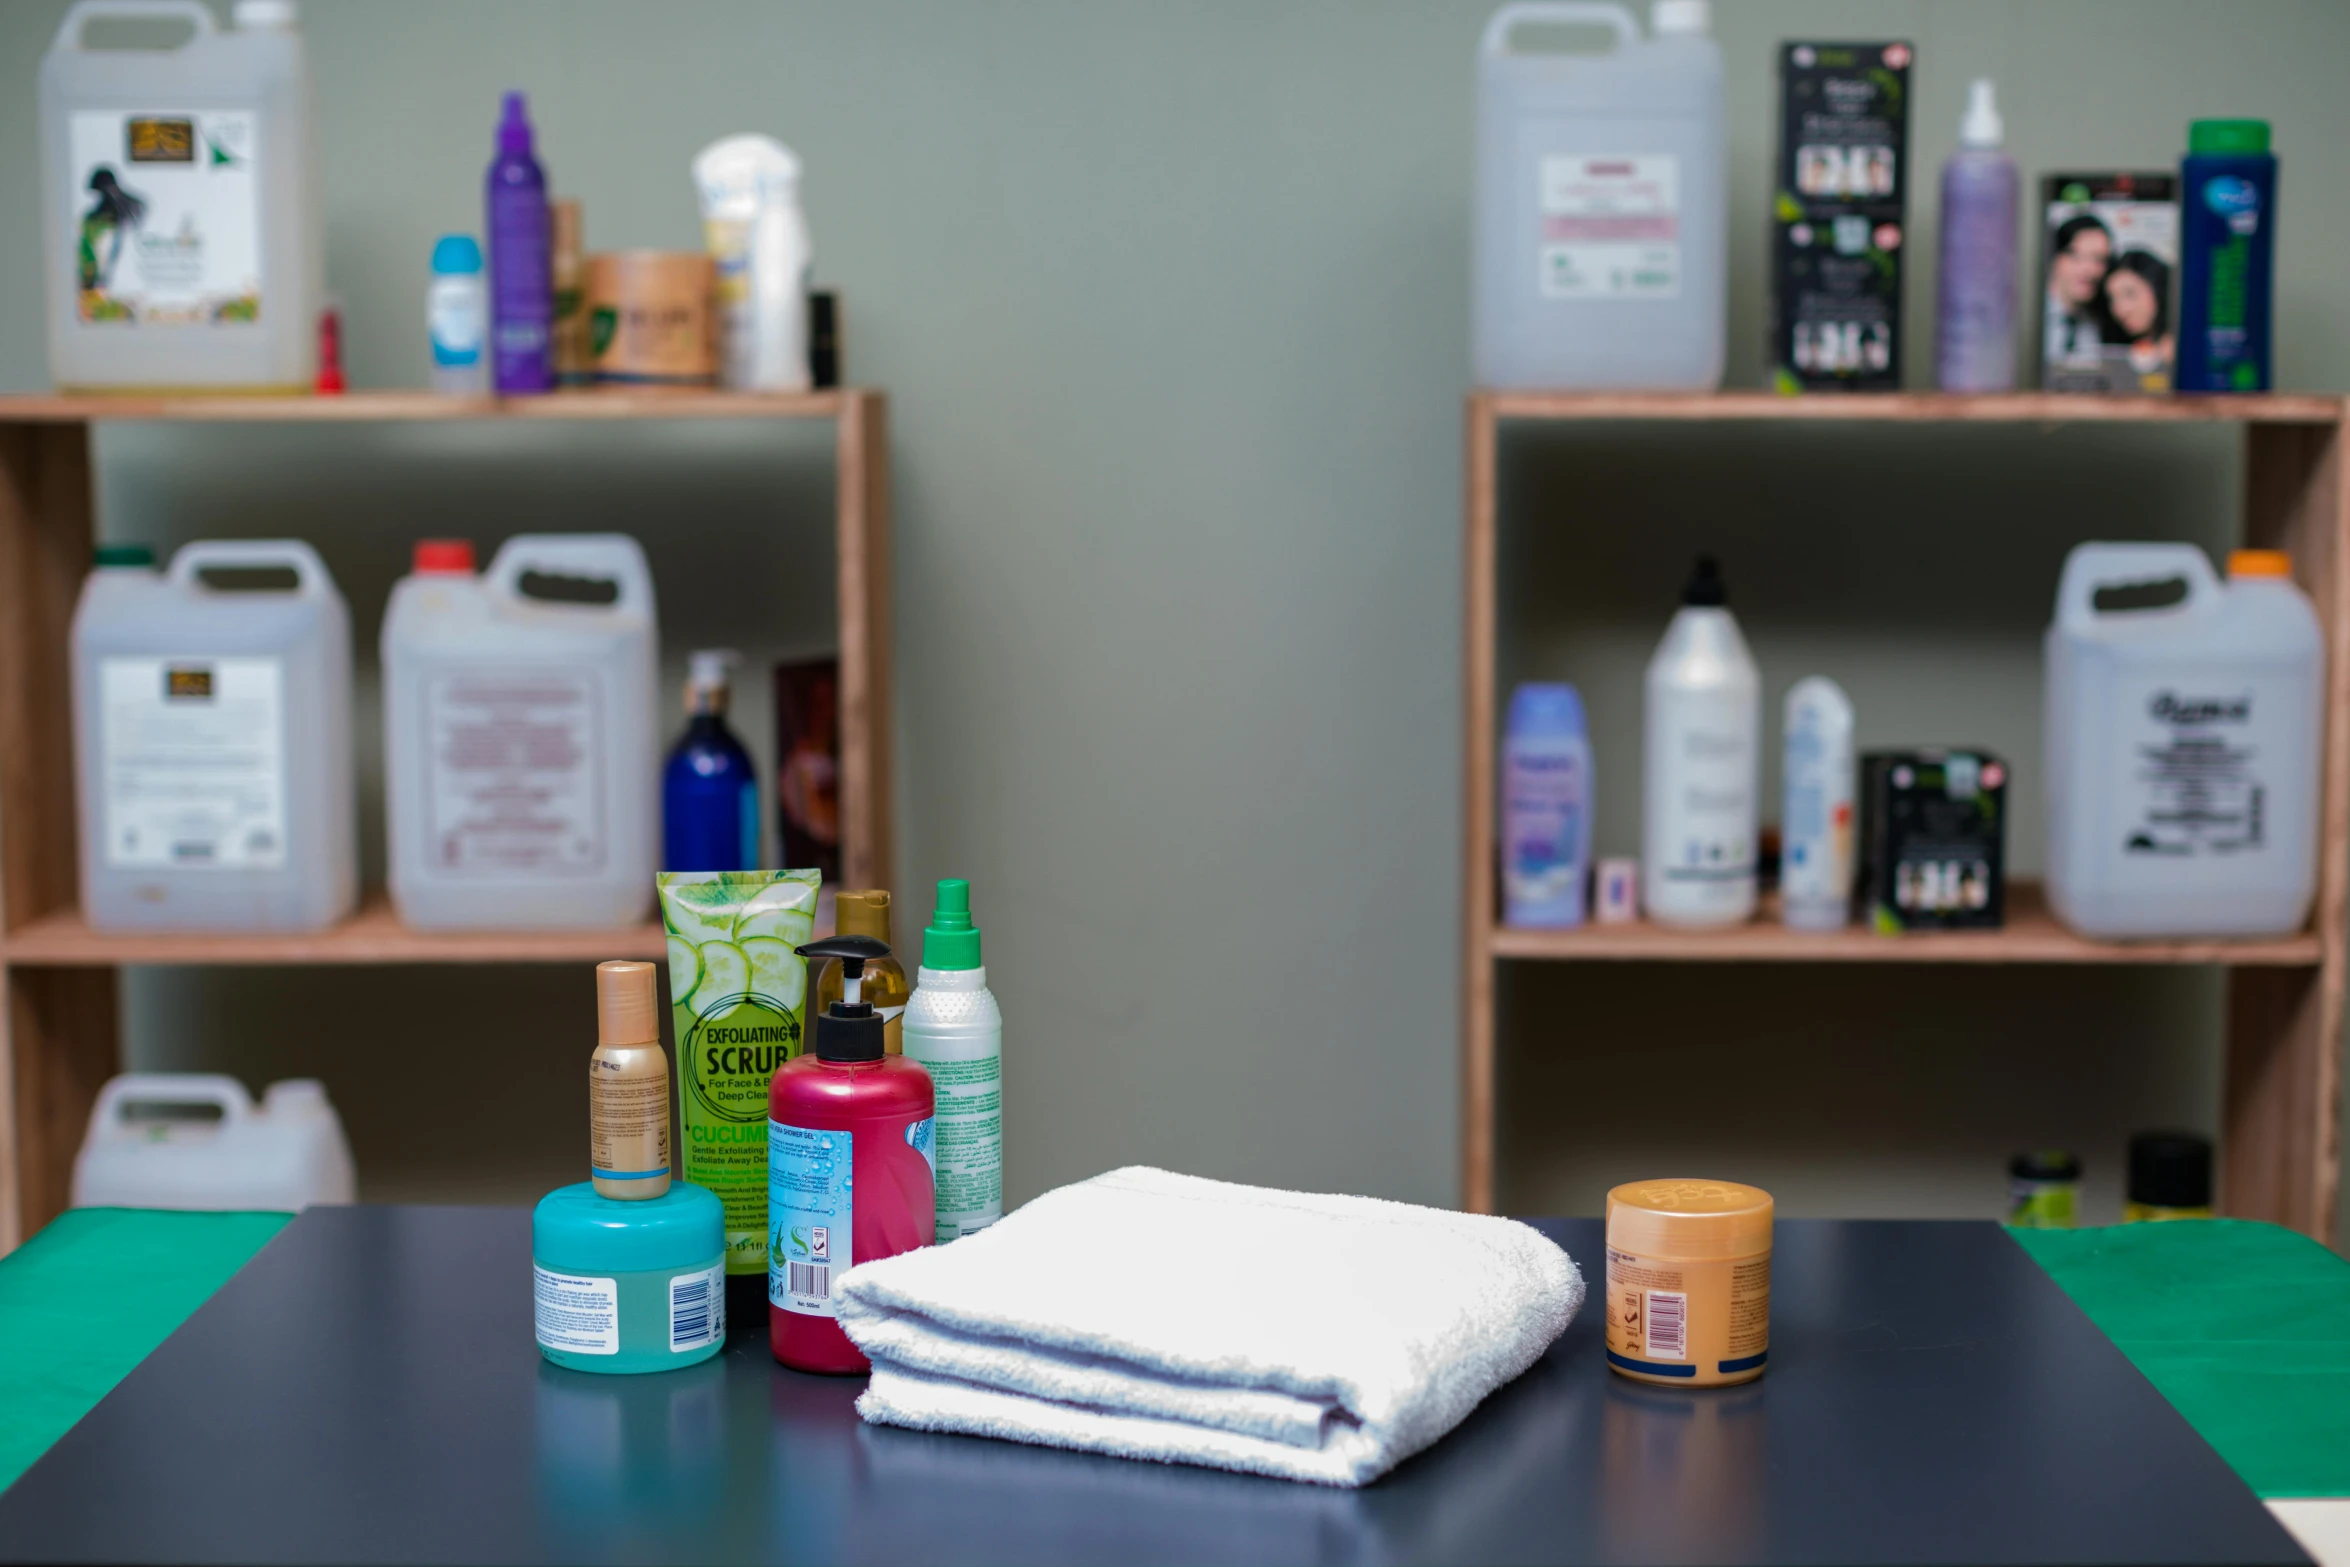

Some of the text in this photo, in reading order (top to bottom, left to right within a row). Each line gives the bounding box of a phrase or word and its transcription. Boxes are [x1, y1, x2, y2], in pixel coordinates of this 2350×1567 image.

[706, 1026, 788, 1044] EXFOLIATING
[706, 1046, 788, 1074] SCRUB
[709, 1078, 761, 1088] For Face &
[718, 1092, 744, 1101] Deep
[784, 1128, 802, 1138] SHOWER
[692, 1146, 764, 1156] Gentle Exfoliating
[692, 1155, 725, 1164] Exfoliate
[728, 1157, 750, 1165] Away
